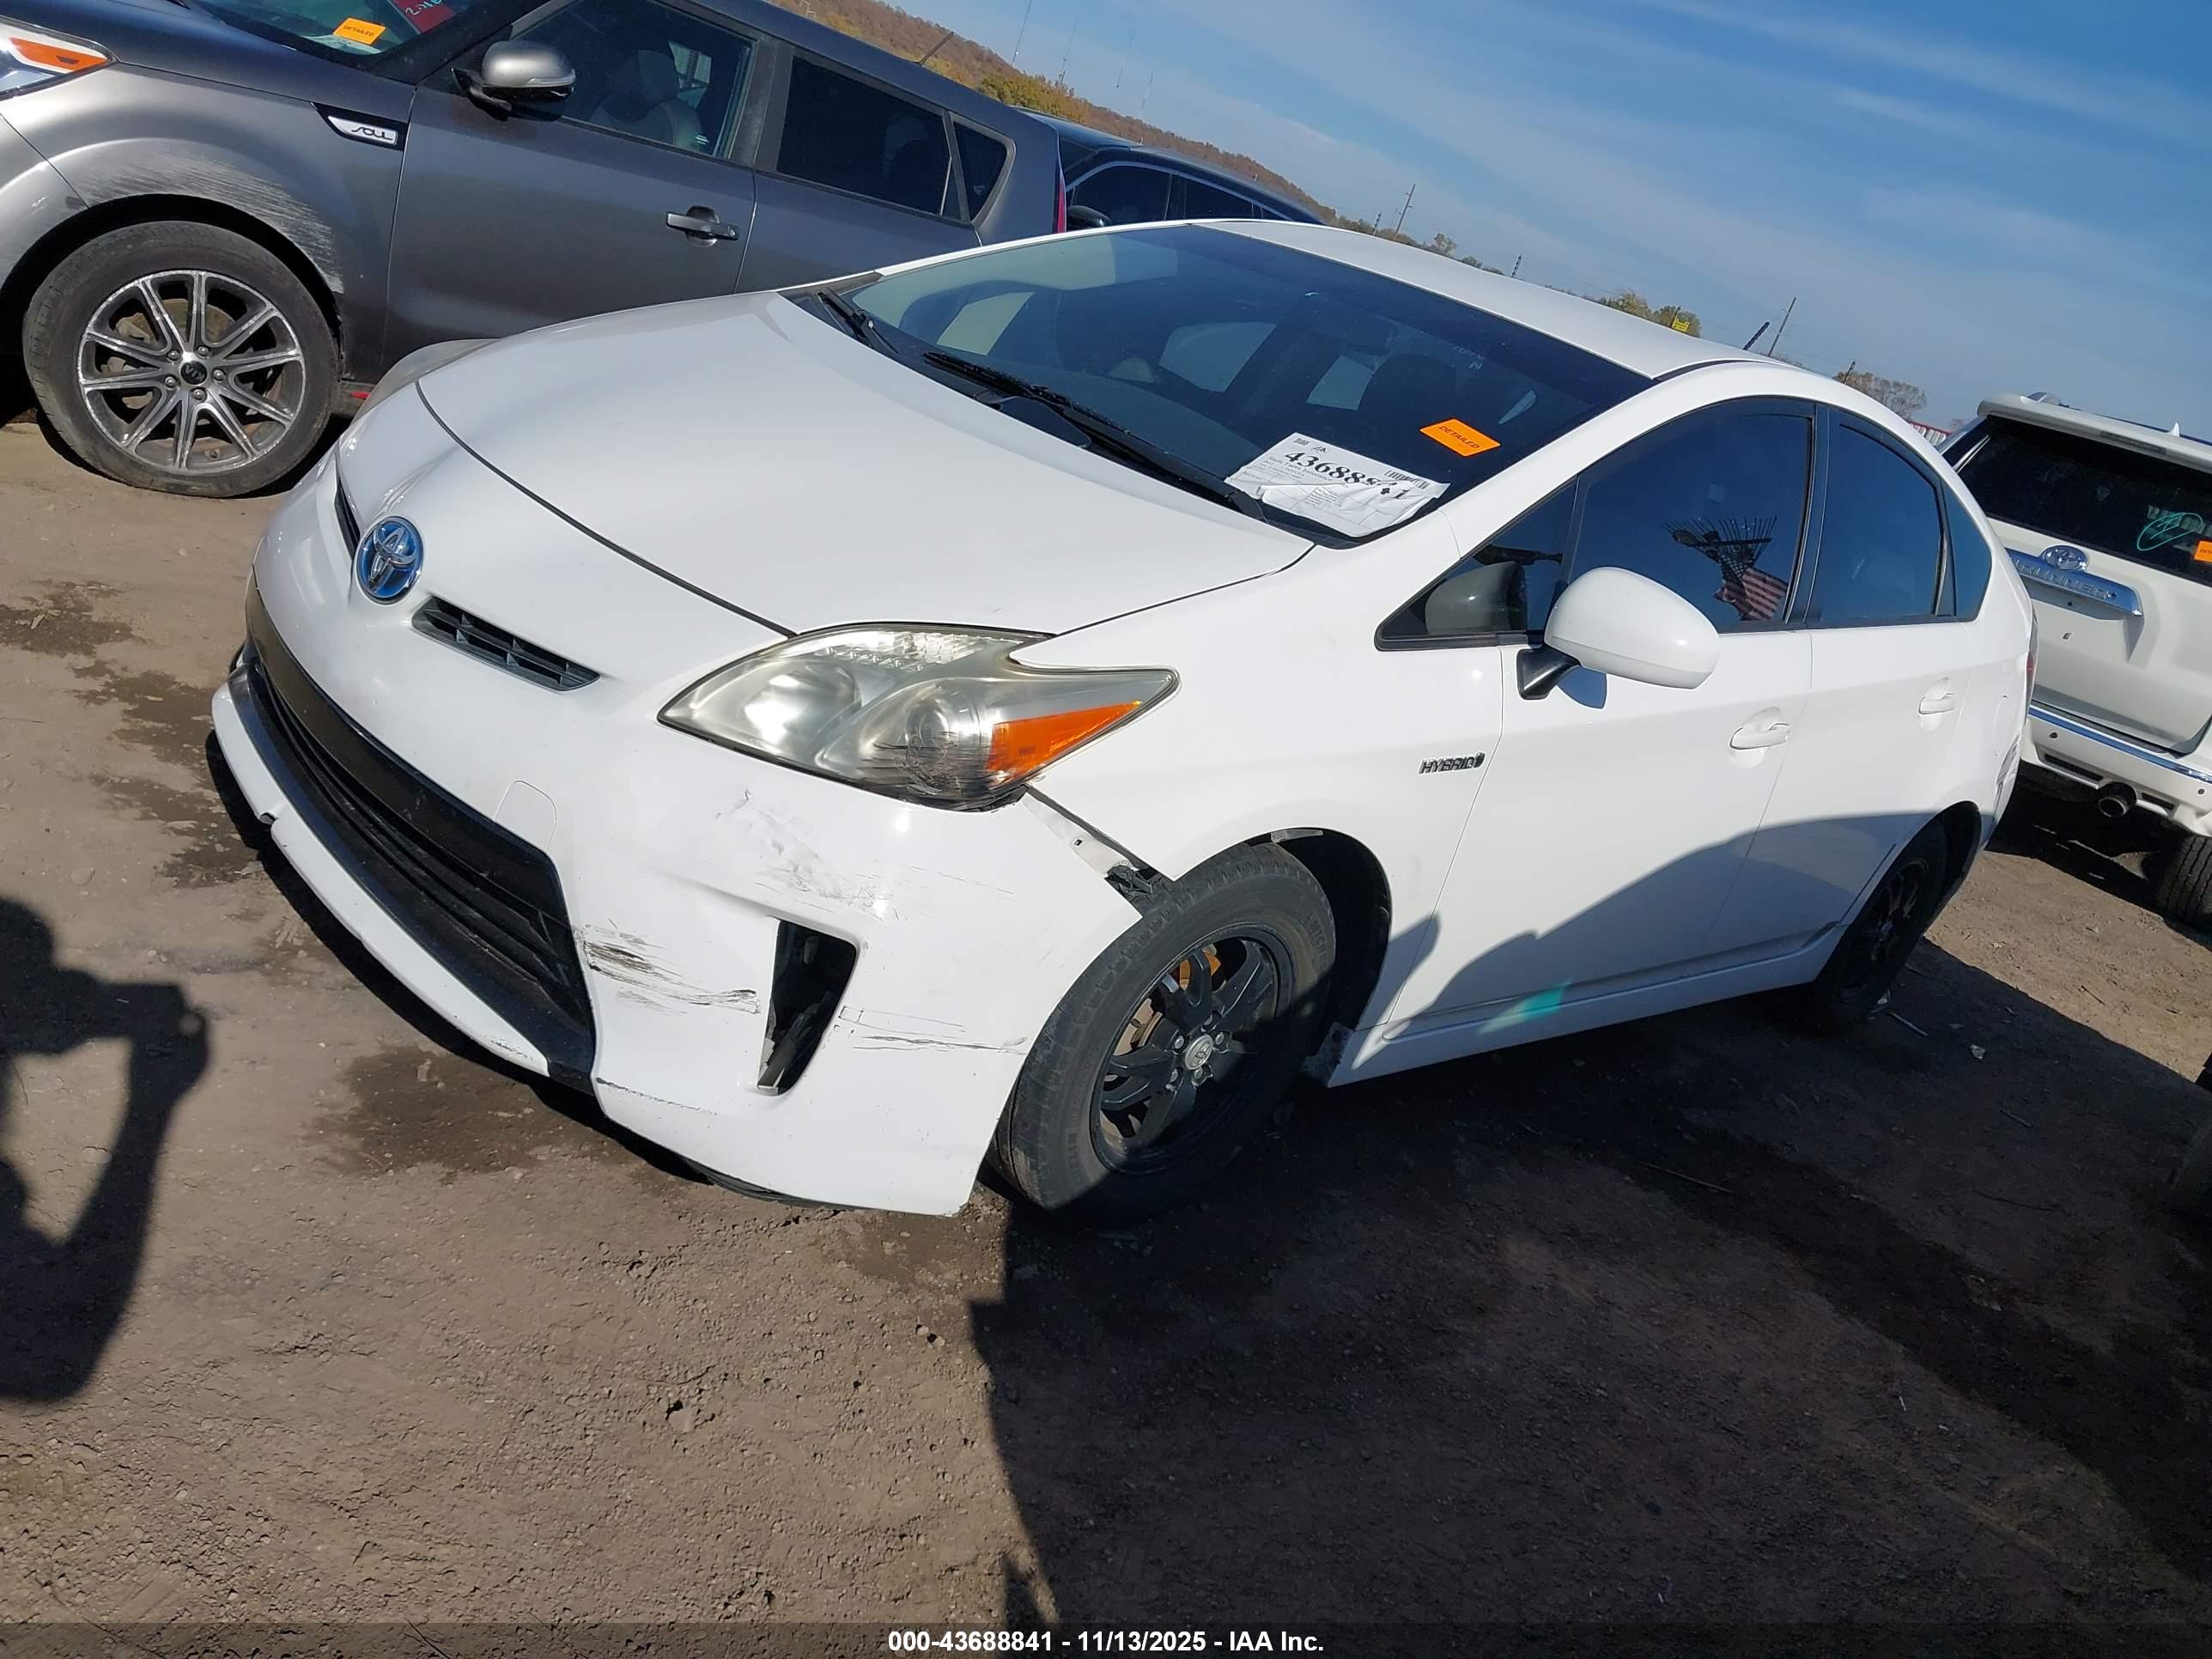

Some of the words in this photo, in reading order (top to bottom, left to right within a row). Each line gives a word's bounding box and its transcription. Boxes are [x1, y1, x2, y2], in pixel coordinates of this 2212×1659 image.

[343, 25, 374, 36] DETAILED
[351, 126, 392, 141] SOUL
[1438, 426, 1480, 448] DETAILED
[1419, 757, 1475, 774] HYBRID
